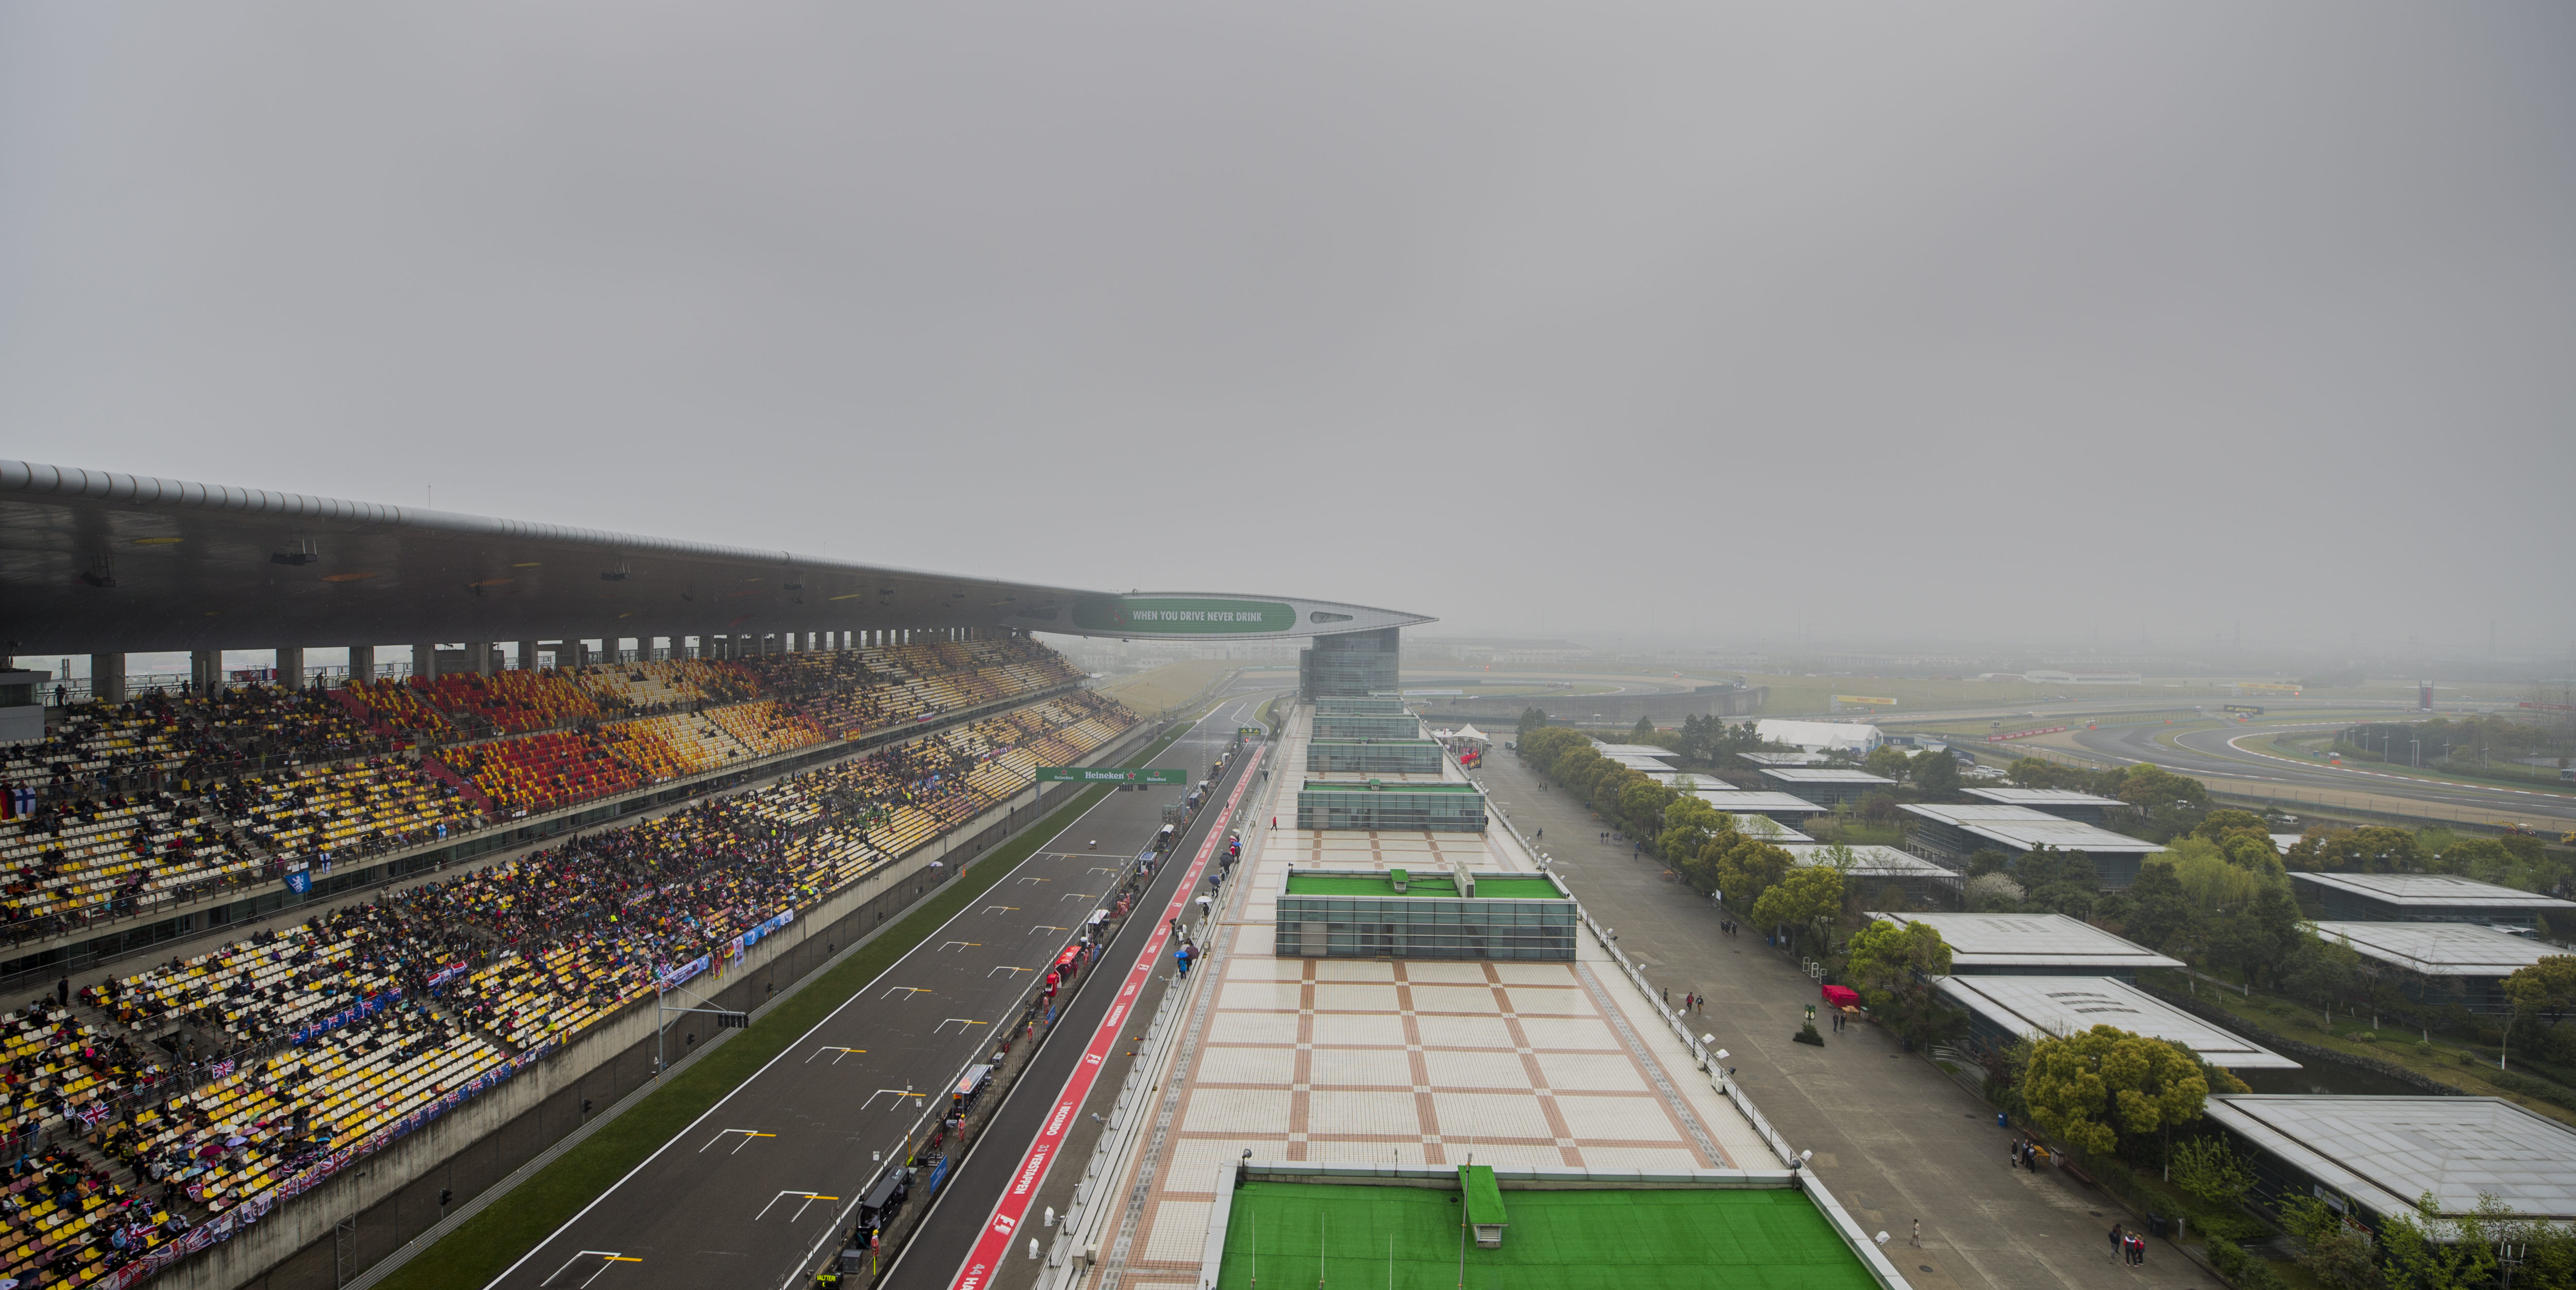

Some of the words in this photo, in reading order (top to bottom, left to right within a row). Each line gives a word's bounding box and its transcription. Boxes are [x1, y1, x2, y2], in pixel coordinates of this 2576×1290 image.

[1133, 611, 1158, 620] WHEN
[1160, 611, 1178, 620] YOU
[1180, 611, 1205, 621] DRIVE
[1208, 612, 1233, 621] NEVER
[1236, 612, 1262, 622] DRINK
[1085, 771, 1124, 779] Heineken
[1046, 1106, 1071, 1135] RICCIARDO
[1014, 1153, 1045, 1194] VERSTAPPEN
[970, 1264, 985, 1275] 44
